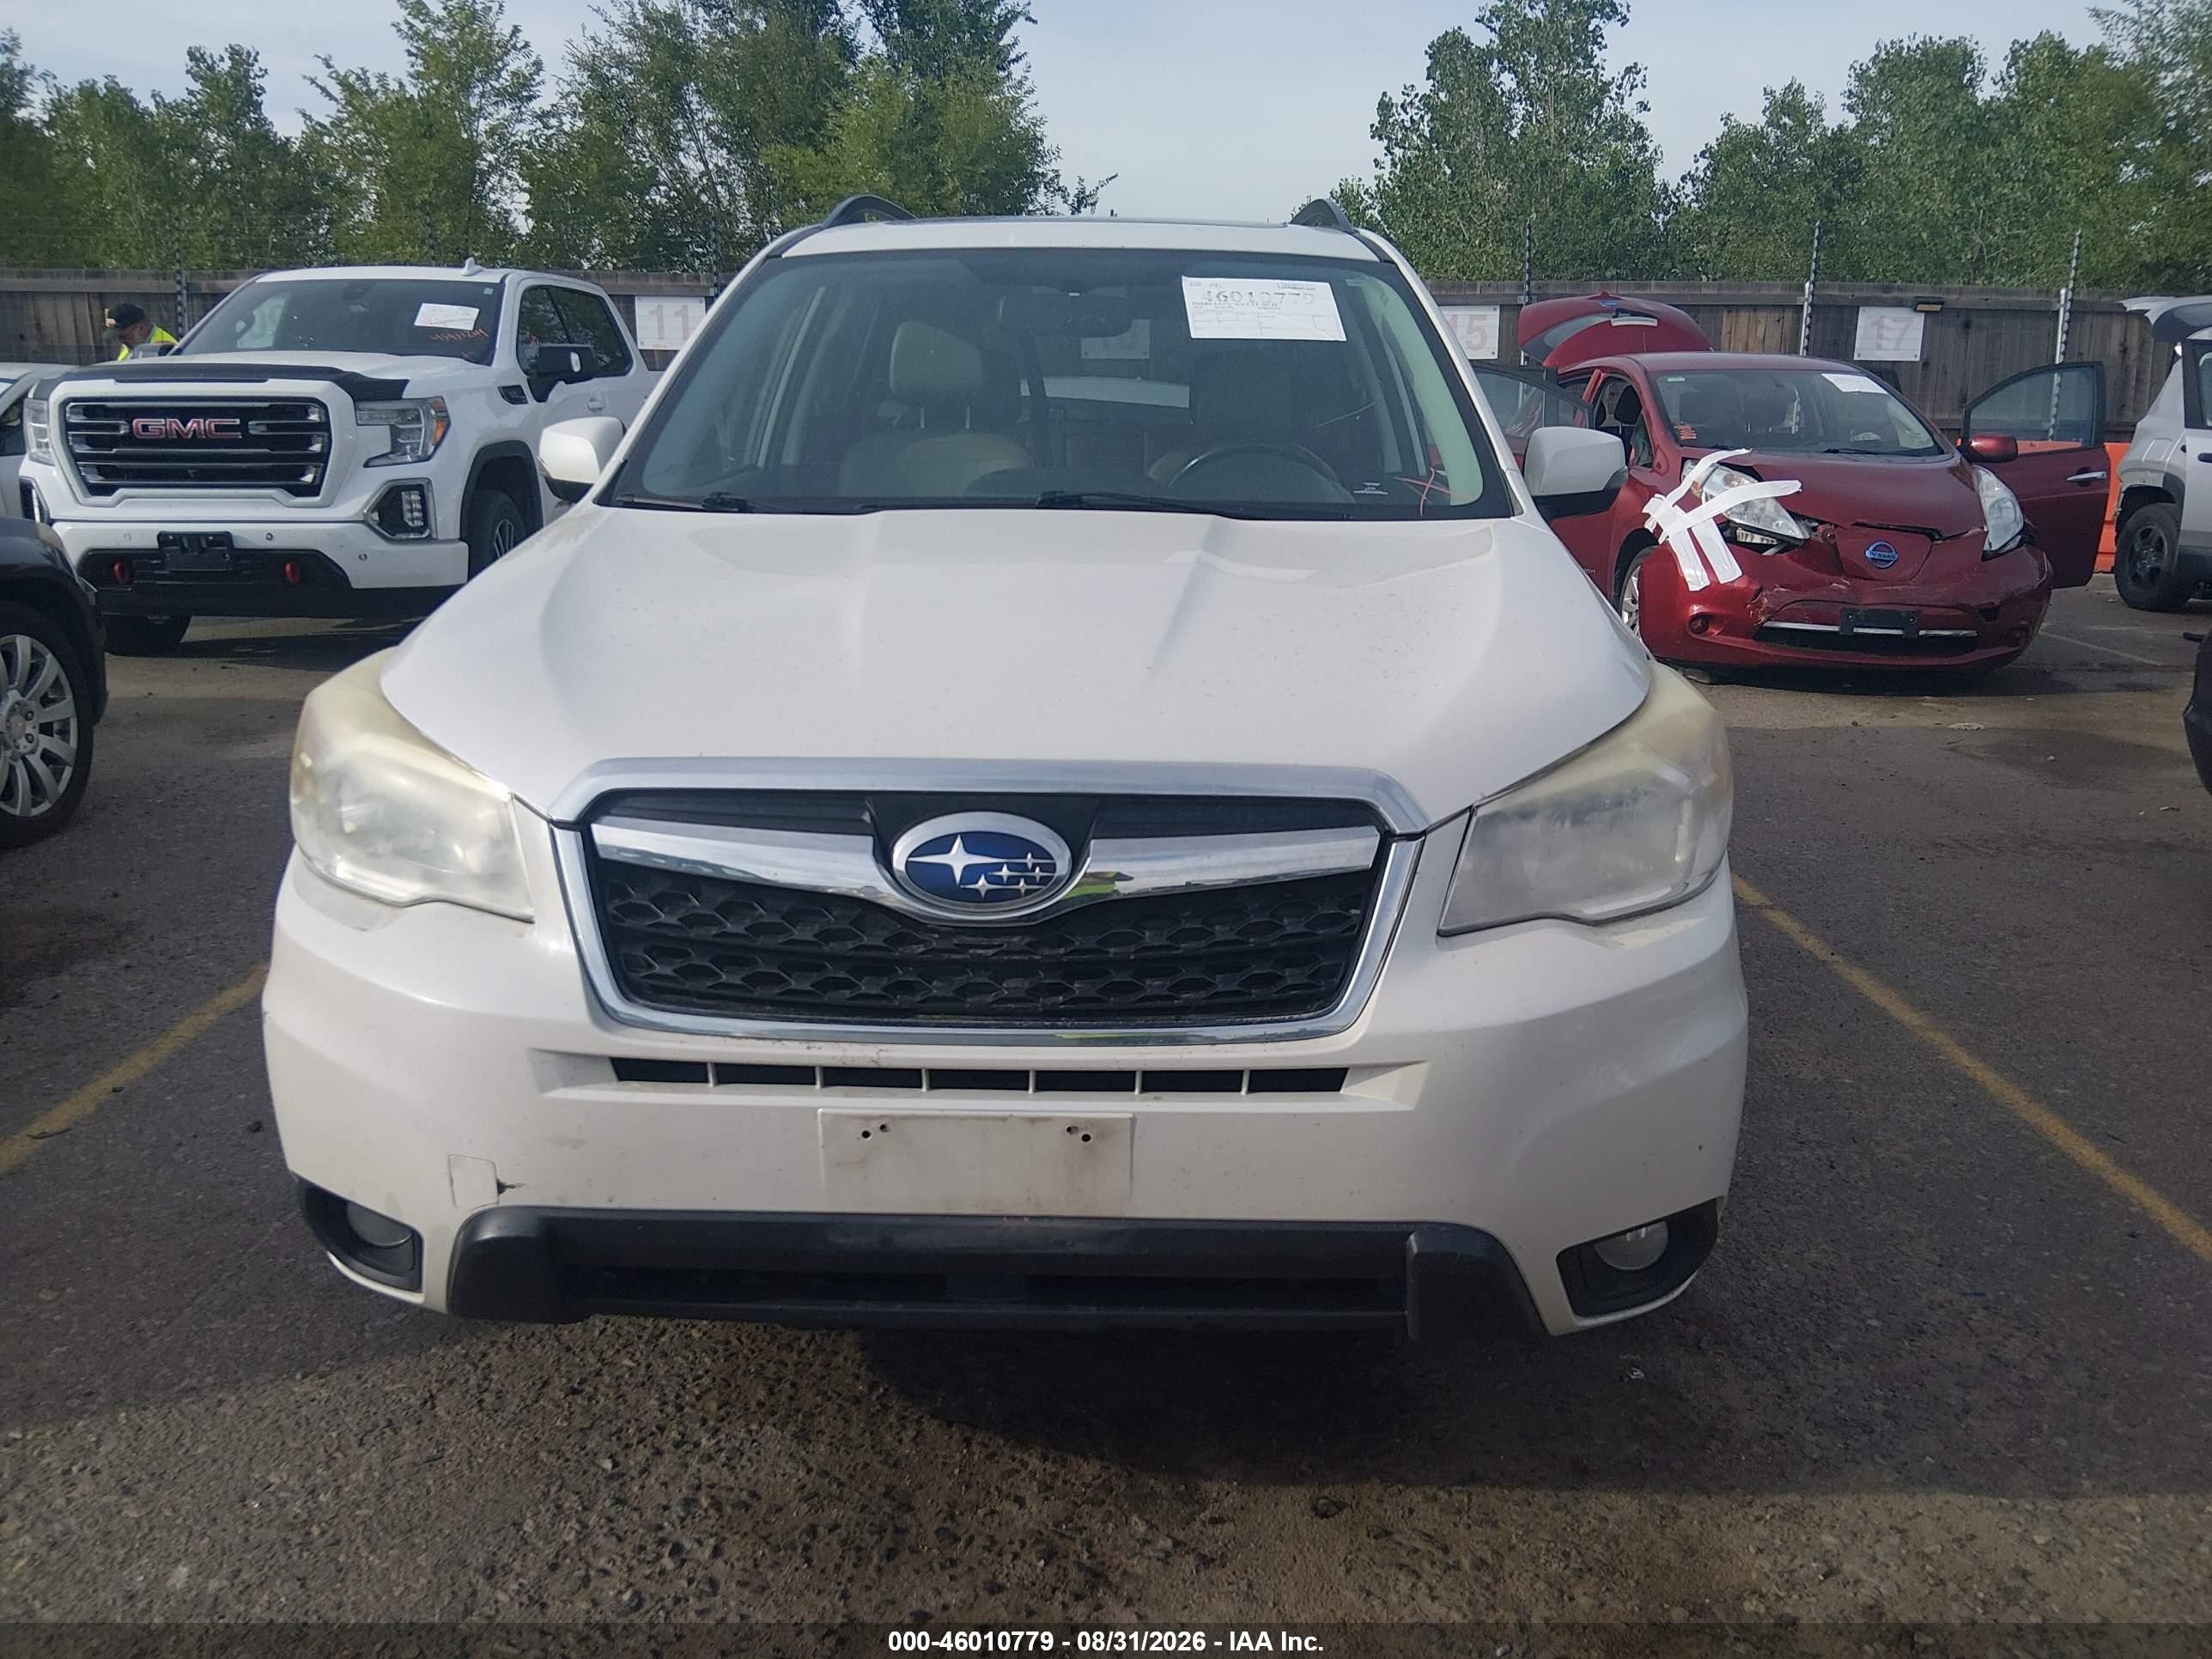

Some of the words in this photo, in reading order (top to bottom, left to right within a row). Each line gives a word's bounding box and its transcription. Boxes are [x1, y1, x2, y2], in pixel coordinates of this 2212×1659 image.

[648, 304, 690, 341] 11
[1870, 315, 1915, 351] 17
[131, 417, 243, 440] GMC
[1869, 550, 1896, 560] NISSAN
